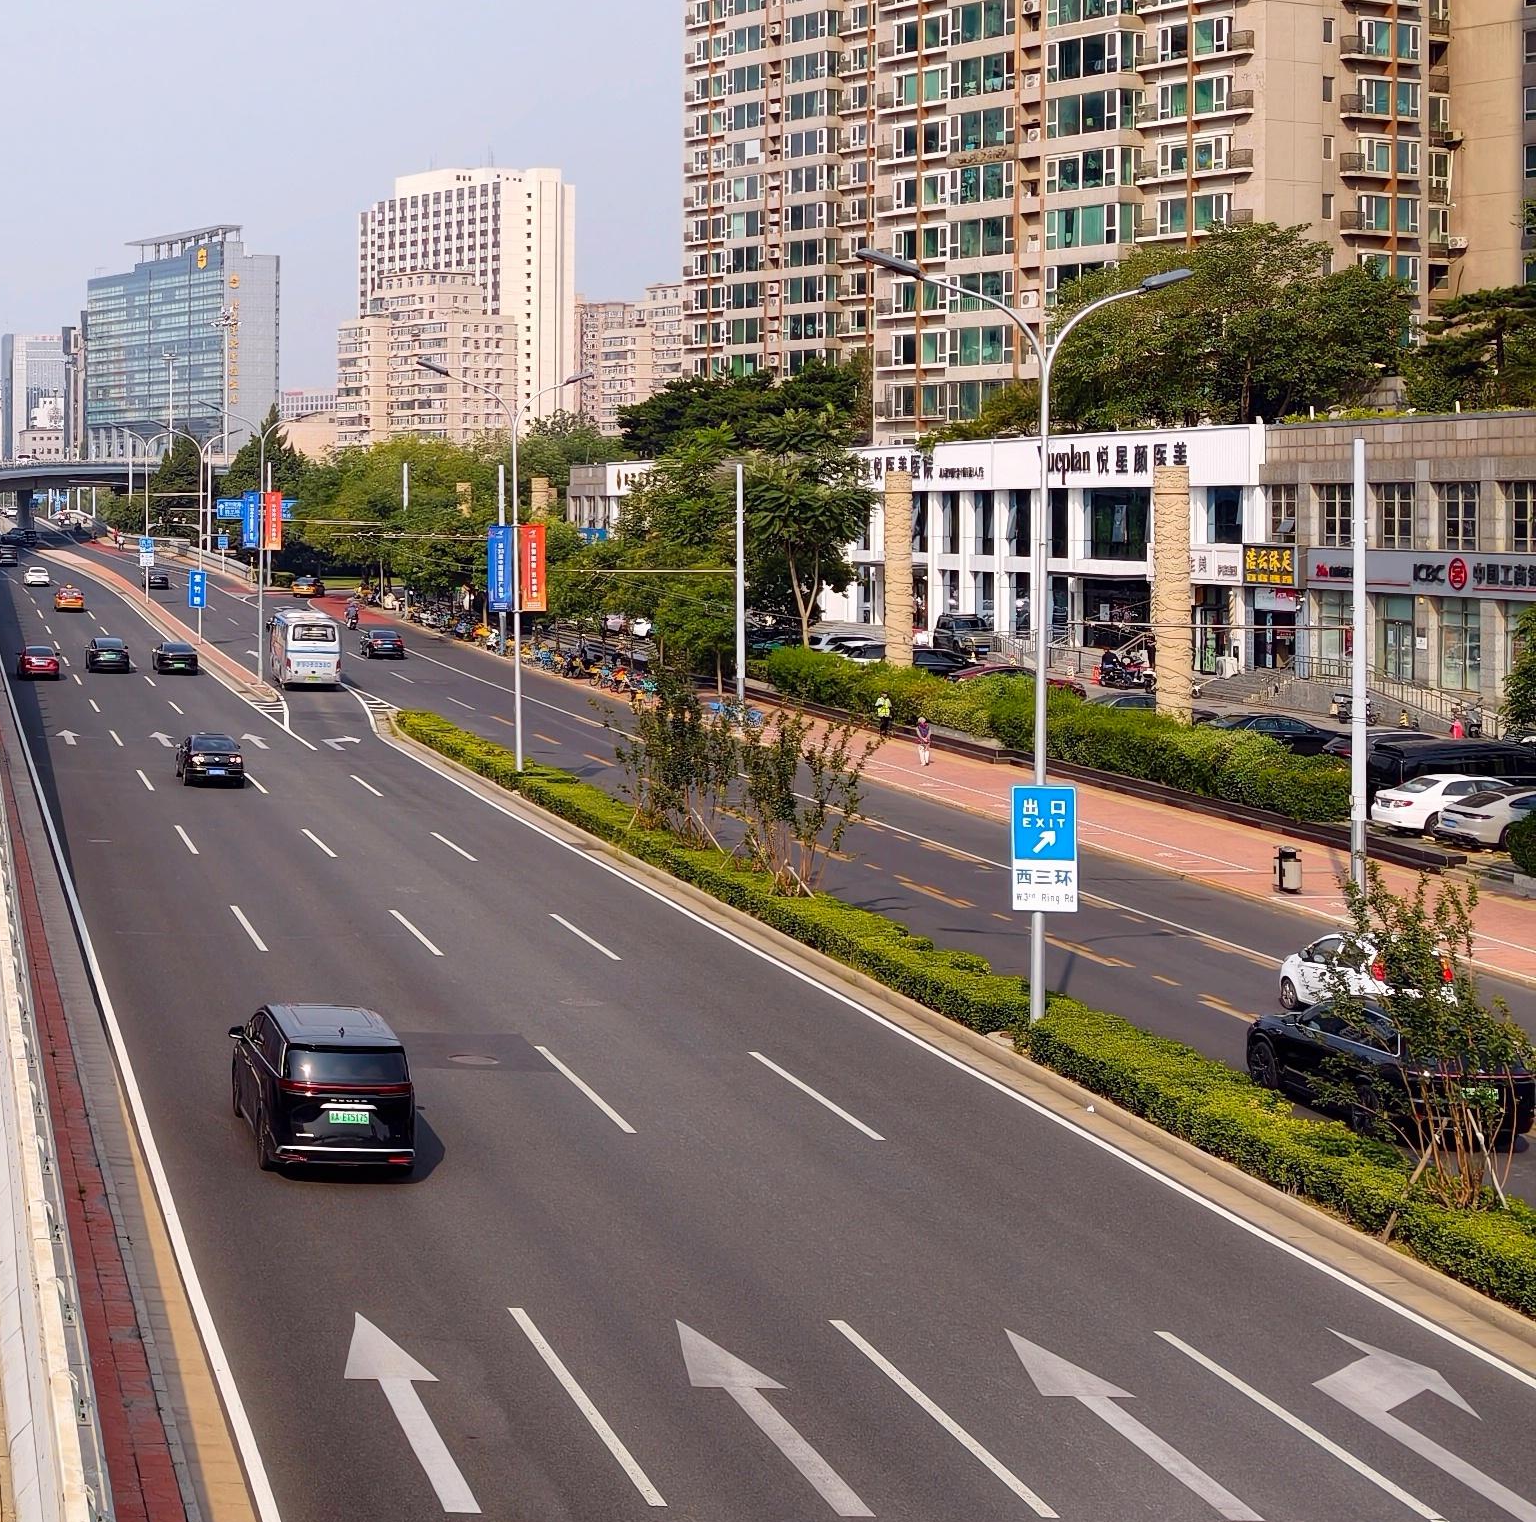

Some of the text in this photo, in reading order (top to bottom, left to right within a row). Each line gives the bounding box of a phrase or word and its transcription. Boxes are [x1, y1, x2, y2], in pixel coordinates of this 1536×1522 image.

[1022, 798, 1066, 816] 出口
[1022, 818, 1066, 829] EXIT
[1015, 868, 1073, 887] 西三环
[1041, 893, 1060, 905] Ring
